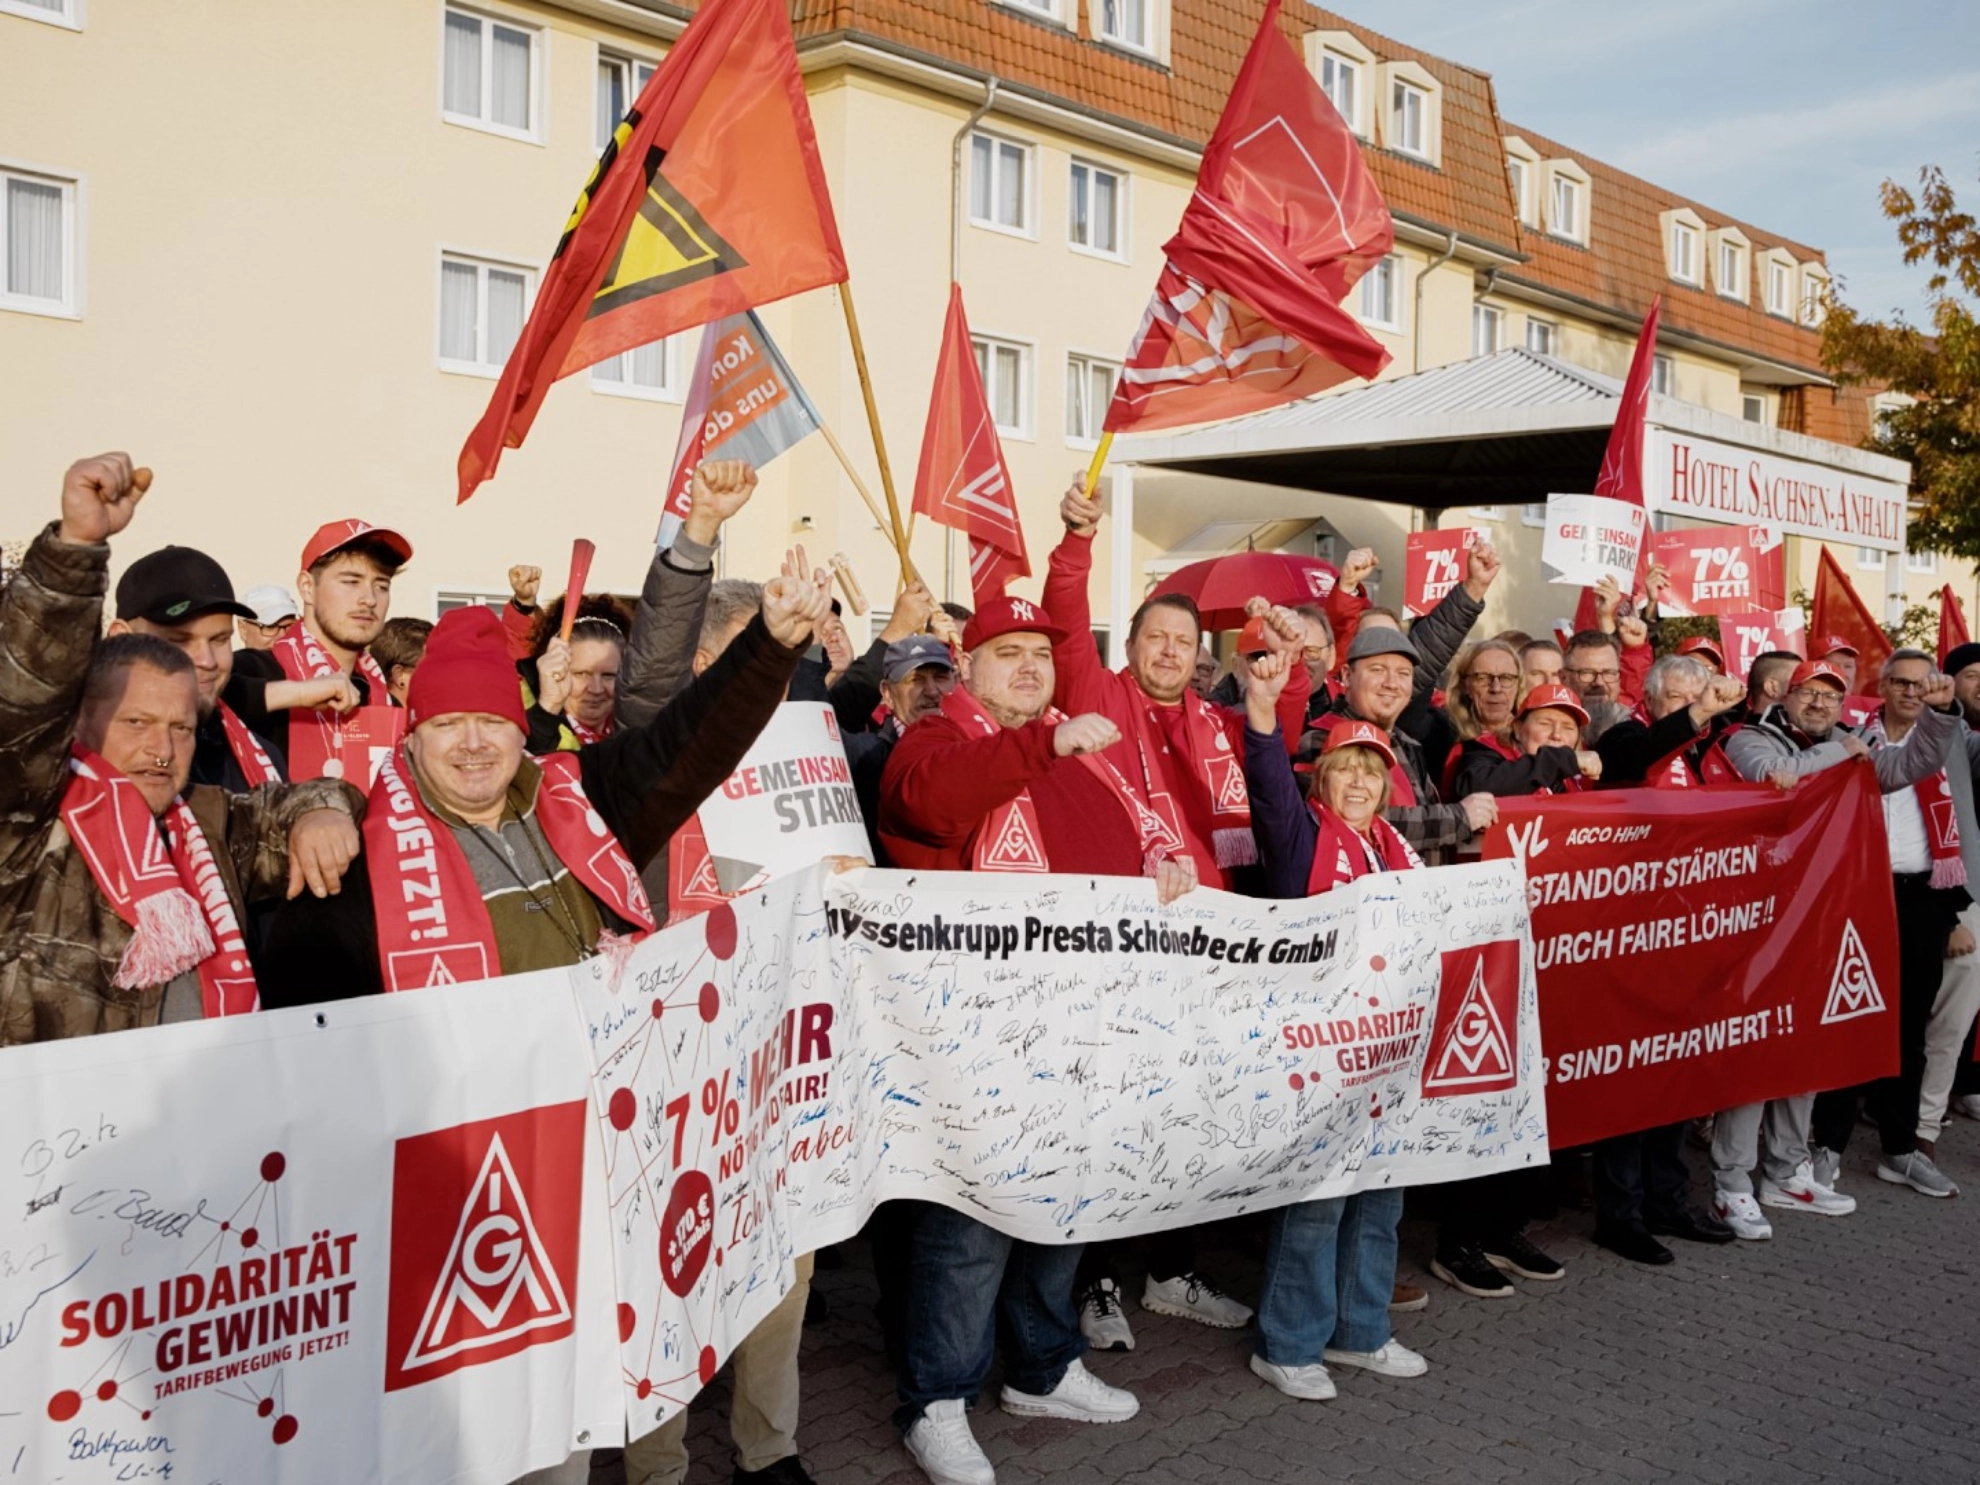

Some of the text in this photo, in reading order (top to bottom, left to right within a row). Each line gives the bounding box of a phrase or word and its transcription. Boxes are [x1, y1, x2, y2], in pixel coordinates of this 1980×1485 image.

[1671, 444, 1743, 513] HOTEL
[1425, 548, 1460, 583] 7%
[1690, 547, 1749, 582] 7%
[1692, 579, 1750, 604] JETZT!
[1736, 626, 1777, 658] 7%
[1566, 826, 1612, 846] AGCO
[1612, 824, 1652, 844] HHM
[387, 814, 449, 941] JETZT!
[1529, 861, 1663, 908] STANDORT
[1664, 846, 1757, 889] STÄRKEN
[823, 900, 1019, 960] hyssenkrupp
[1025, 916, 1112, 953] Presta
[1117, 917, 1265, 965] Schönebeck
[1267, 928, 1339, 965] GmbH
[1532, 928, 1614, 971] URCH
[1618, 916, 1687, 956] FAIRE
[1283, 1002, 1425, 1050] SOLIDARITÄT
[1337, 1034, 1421, 1073] GEWINNT
[1556, 1045, 1623, 1084] SIND
[60, 1229, 358, 1347] SOLIDARITÄT
[155, 1281, 357, 1373] GEWINNT
[154, 1331, 350, 1400] TARIFBEWEGUNG JETZT!
